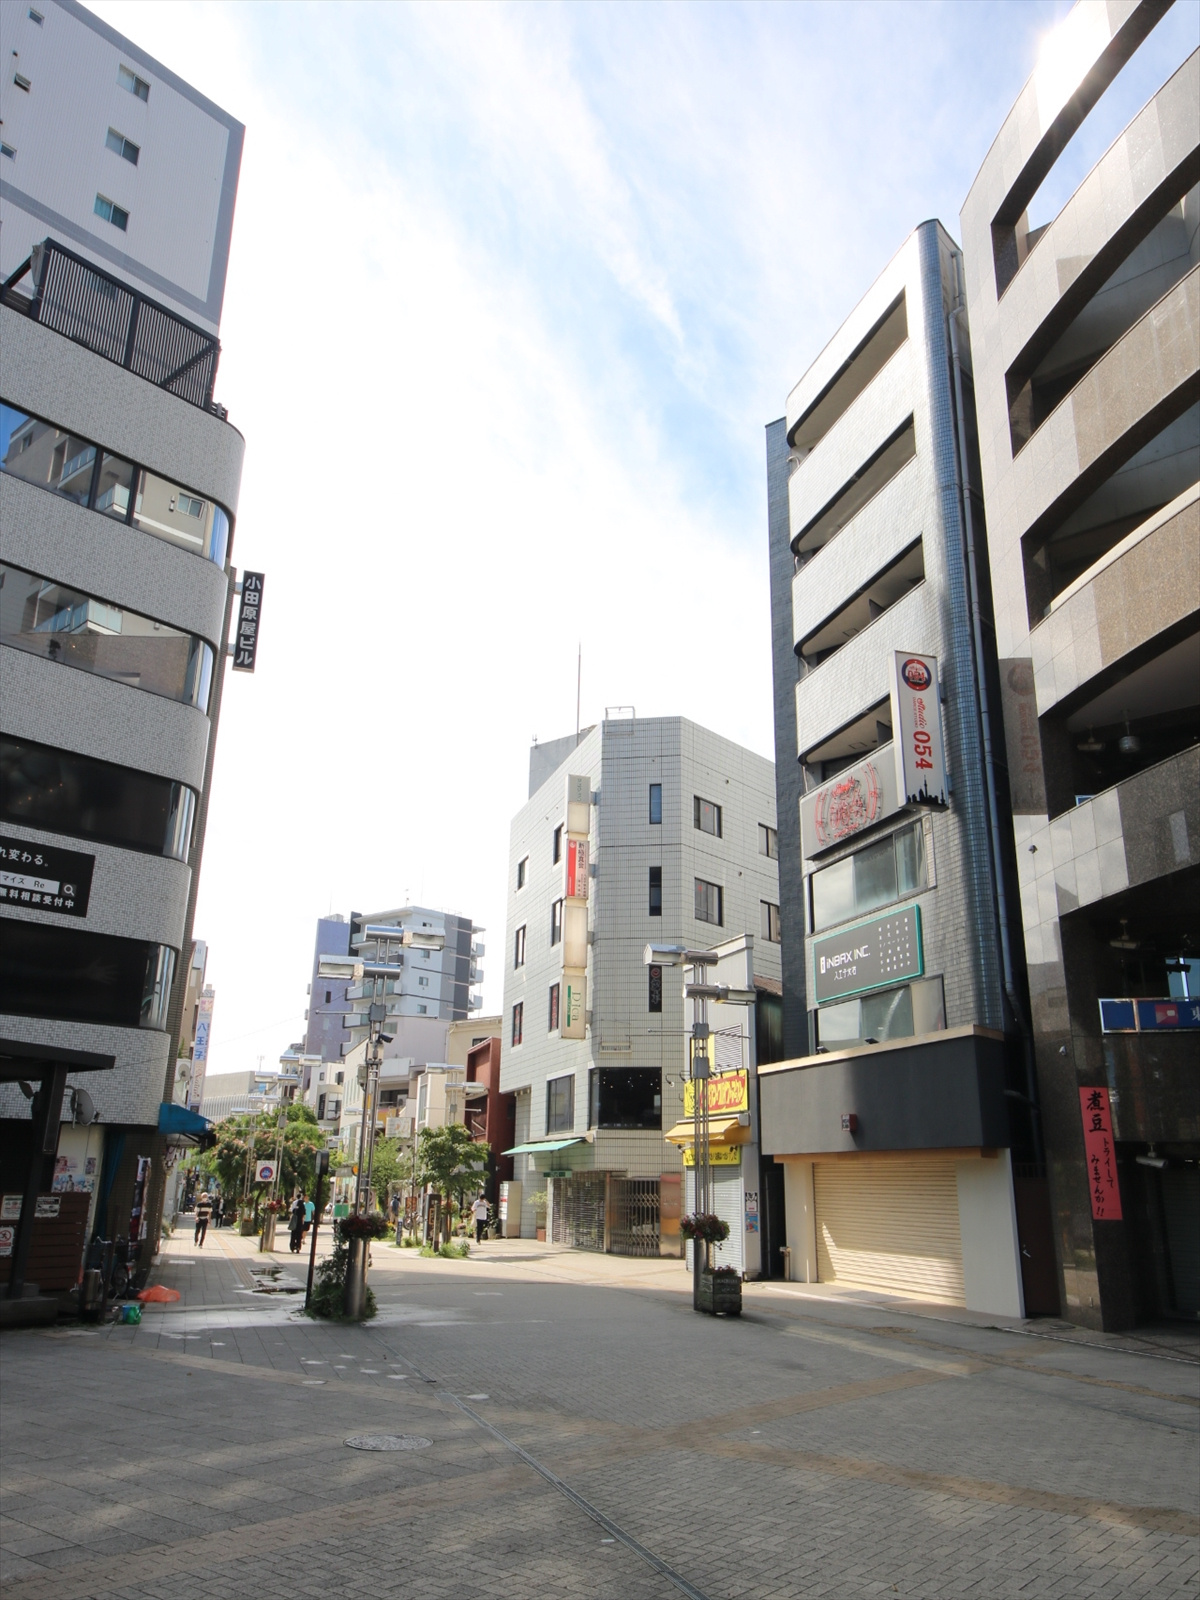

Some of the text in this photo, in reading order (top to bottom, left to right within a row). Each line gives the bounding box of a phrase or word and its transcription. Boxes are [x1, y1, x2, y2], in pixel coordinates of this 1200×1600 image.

[237, 576, 261, 665] 小田原屋ビル
[913, 698, 934, 769] Studio 054
[33, 880, 45, 889] Re
[571, 992, 581, 1021] Dica
[195, 1023, 206, 1060] 八王子
[1086, 1090, 1108, 1132] 煮豆
[1103, 1137, 1114, 1188] トライして
